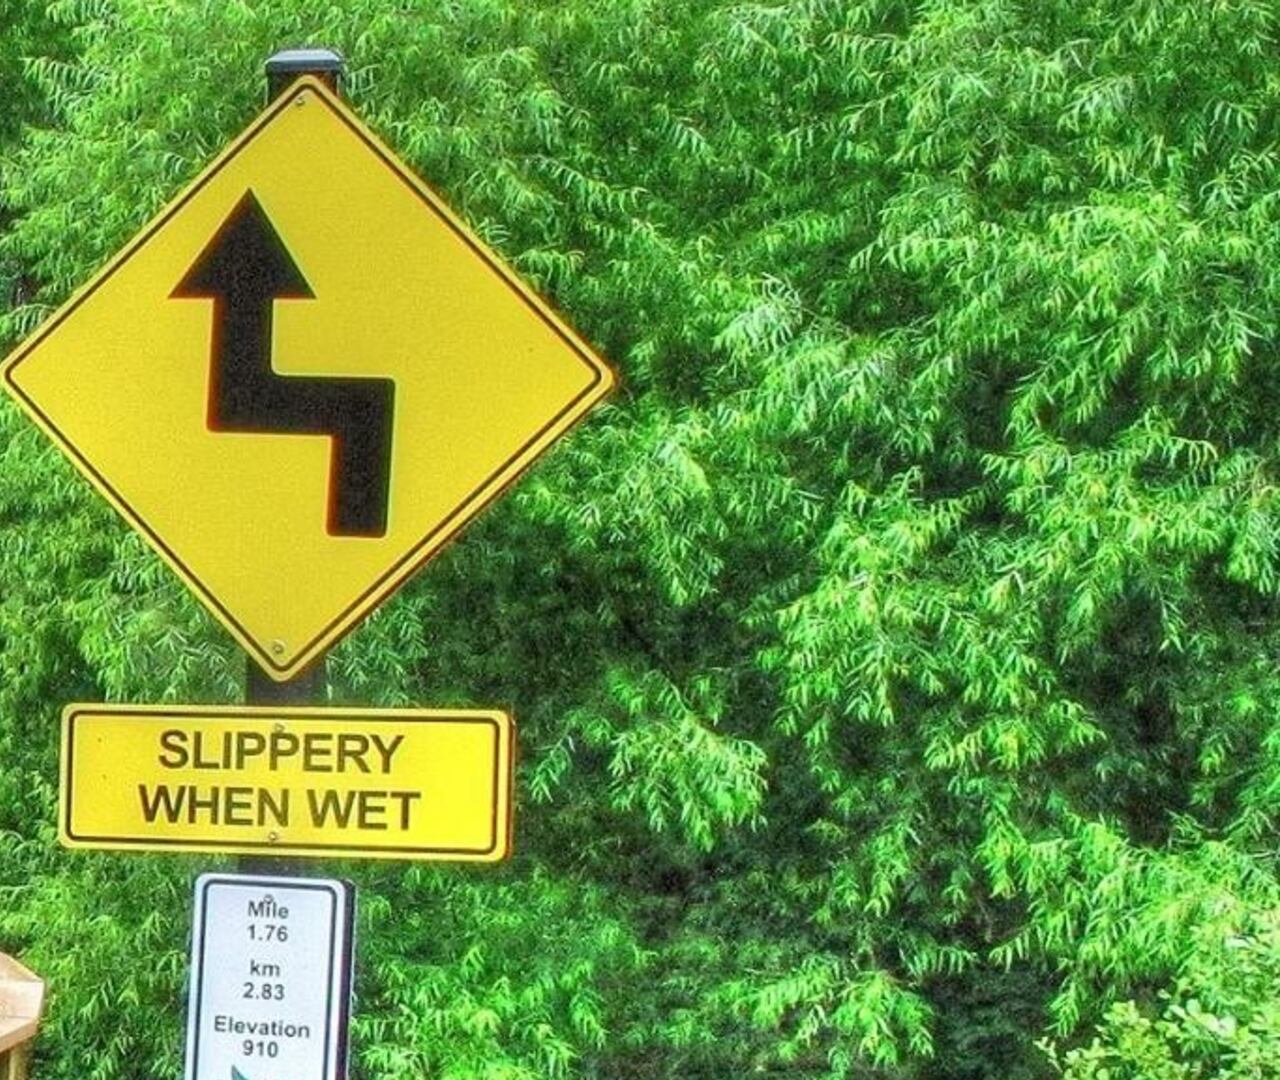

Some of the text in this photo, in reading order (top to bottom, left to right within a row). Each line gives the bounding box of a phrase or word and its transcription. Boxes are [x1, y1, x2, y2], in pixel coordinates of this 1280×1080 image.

[158, 729, 405, 774] SLIPPERY
[138, 784, 421, 831] WHEN WET
[248, 900, 289, 919] Mile
[247, 925, 288, 942] 1.76
[250, 960, 280, 977] km
[243, 982, 285, 1000] 2.83
[214, 1015, 310, 1038] Elevation
[243, 1040, 279, 1058] 910
